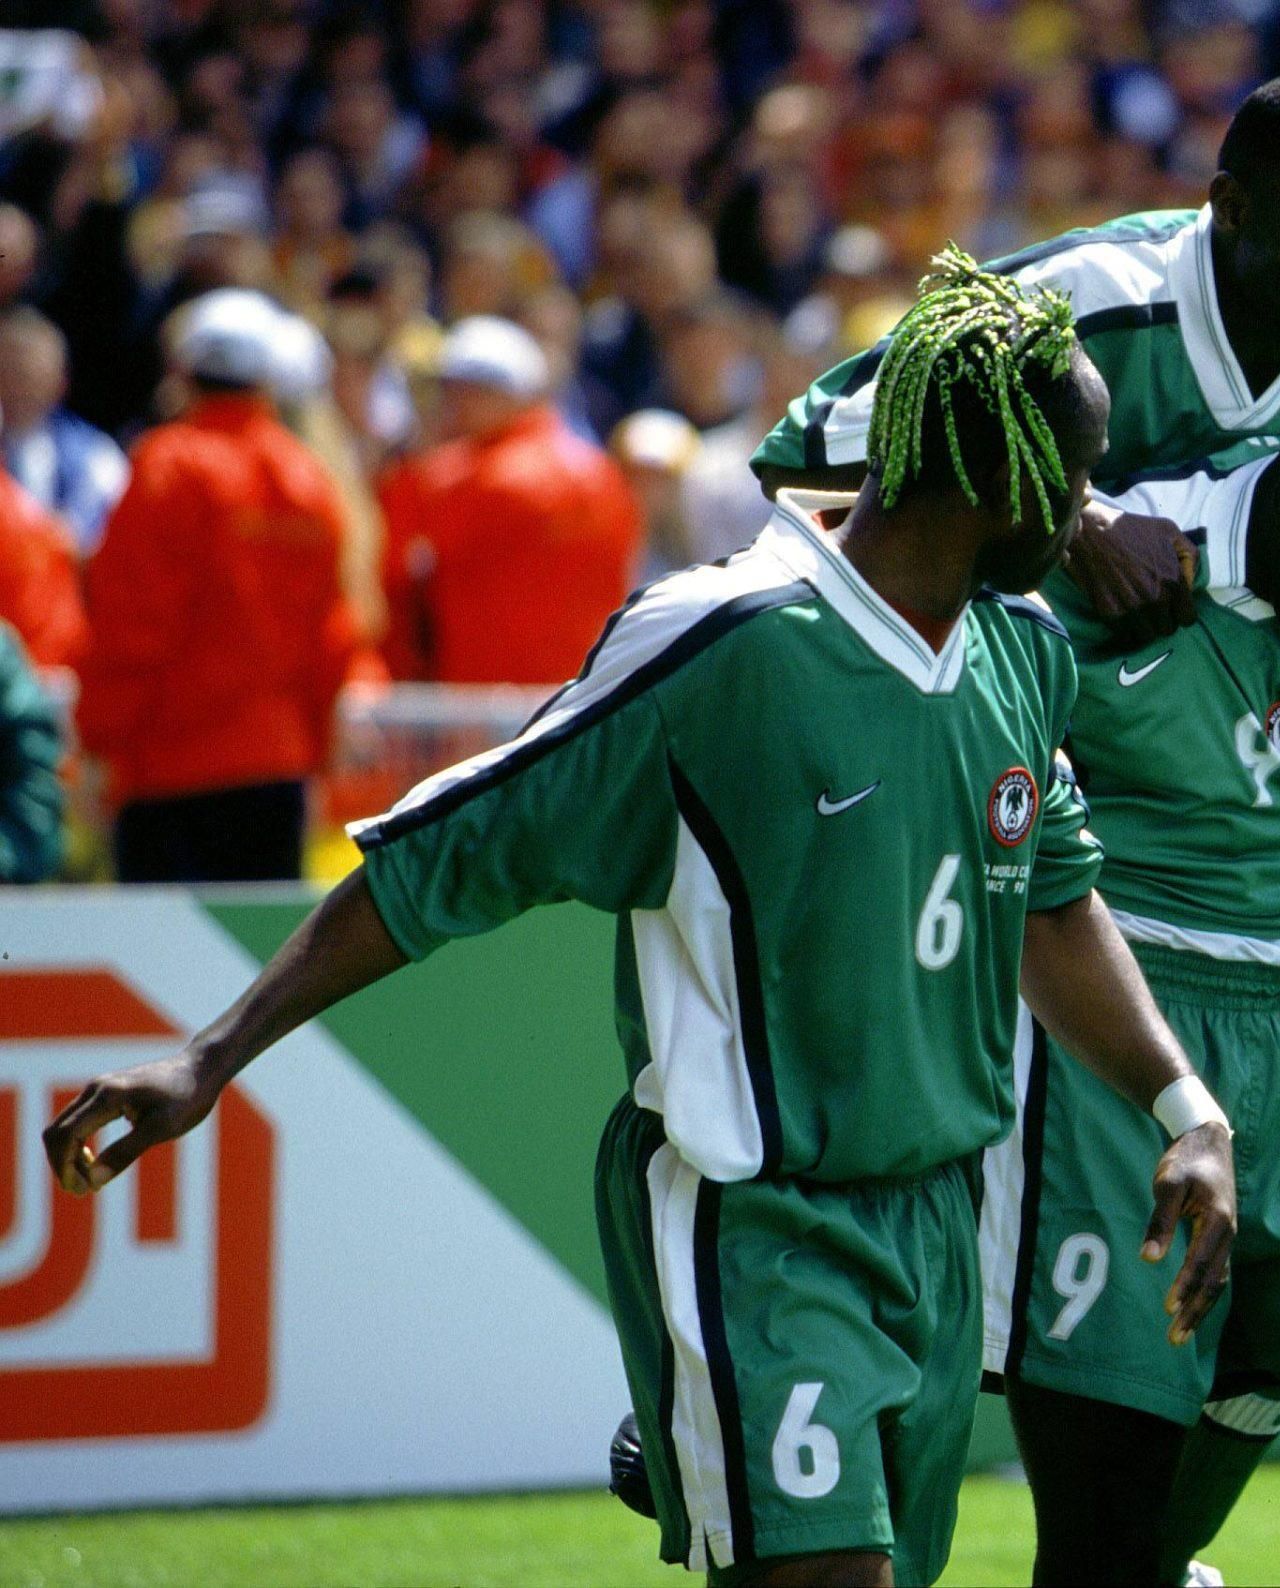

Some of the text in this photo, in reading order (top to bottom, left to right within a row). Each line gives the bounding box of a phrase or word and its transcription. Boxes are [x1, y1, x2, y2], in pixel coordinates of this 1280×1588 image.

[998, 774, 1032, 793] NIGERIA
[991, 864, 1018, 878] WORLD
[1018, 865, 1030, 878] CU
[1013, 881, 1025, 894] 98
[914, 853, 964, 972] 6
[1047, 1232, 1110, 1341] 9
[771, 1381, 841, 1499] 6
